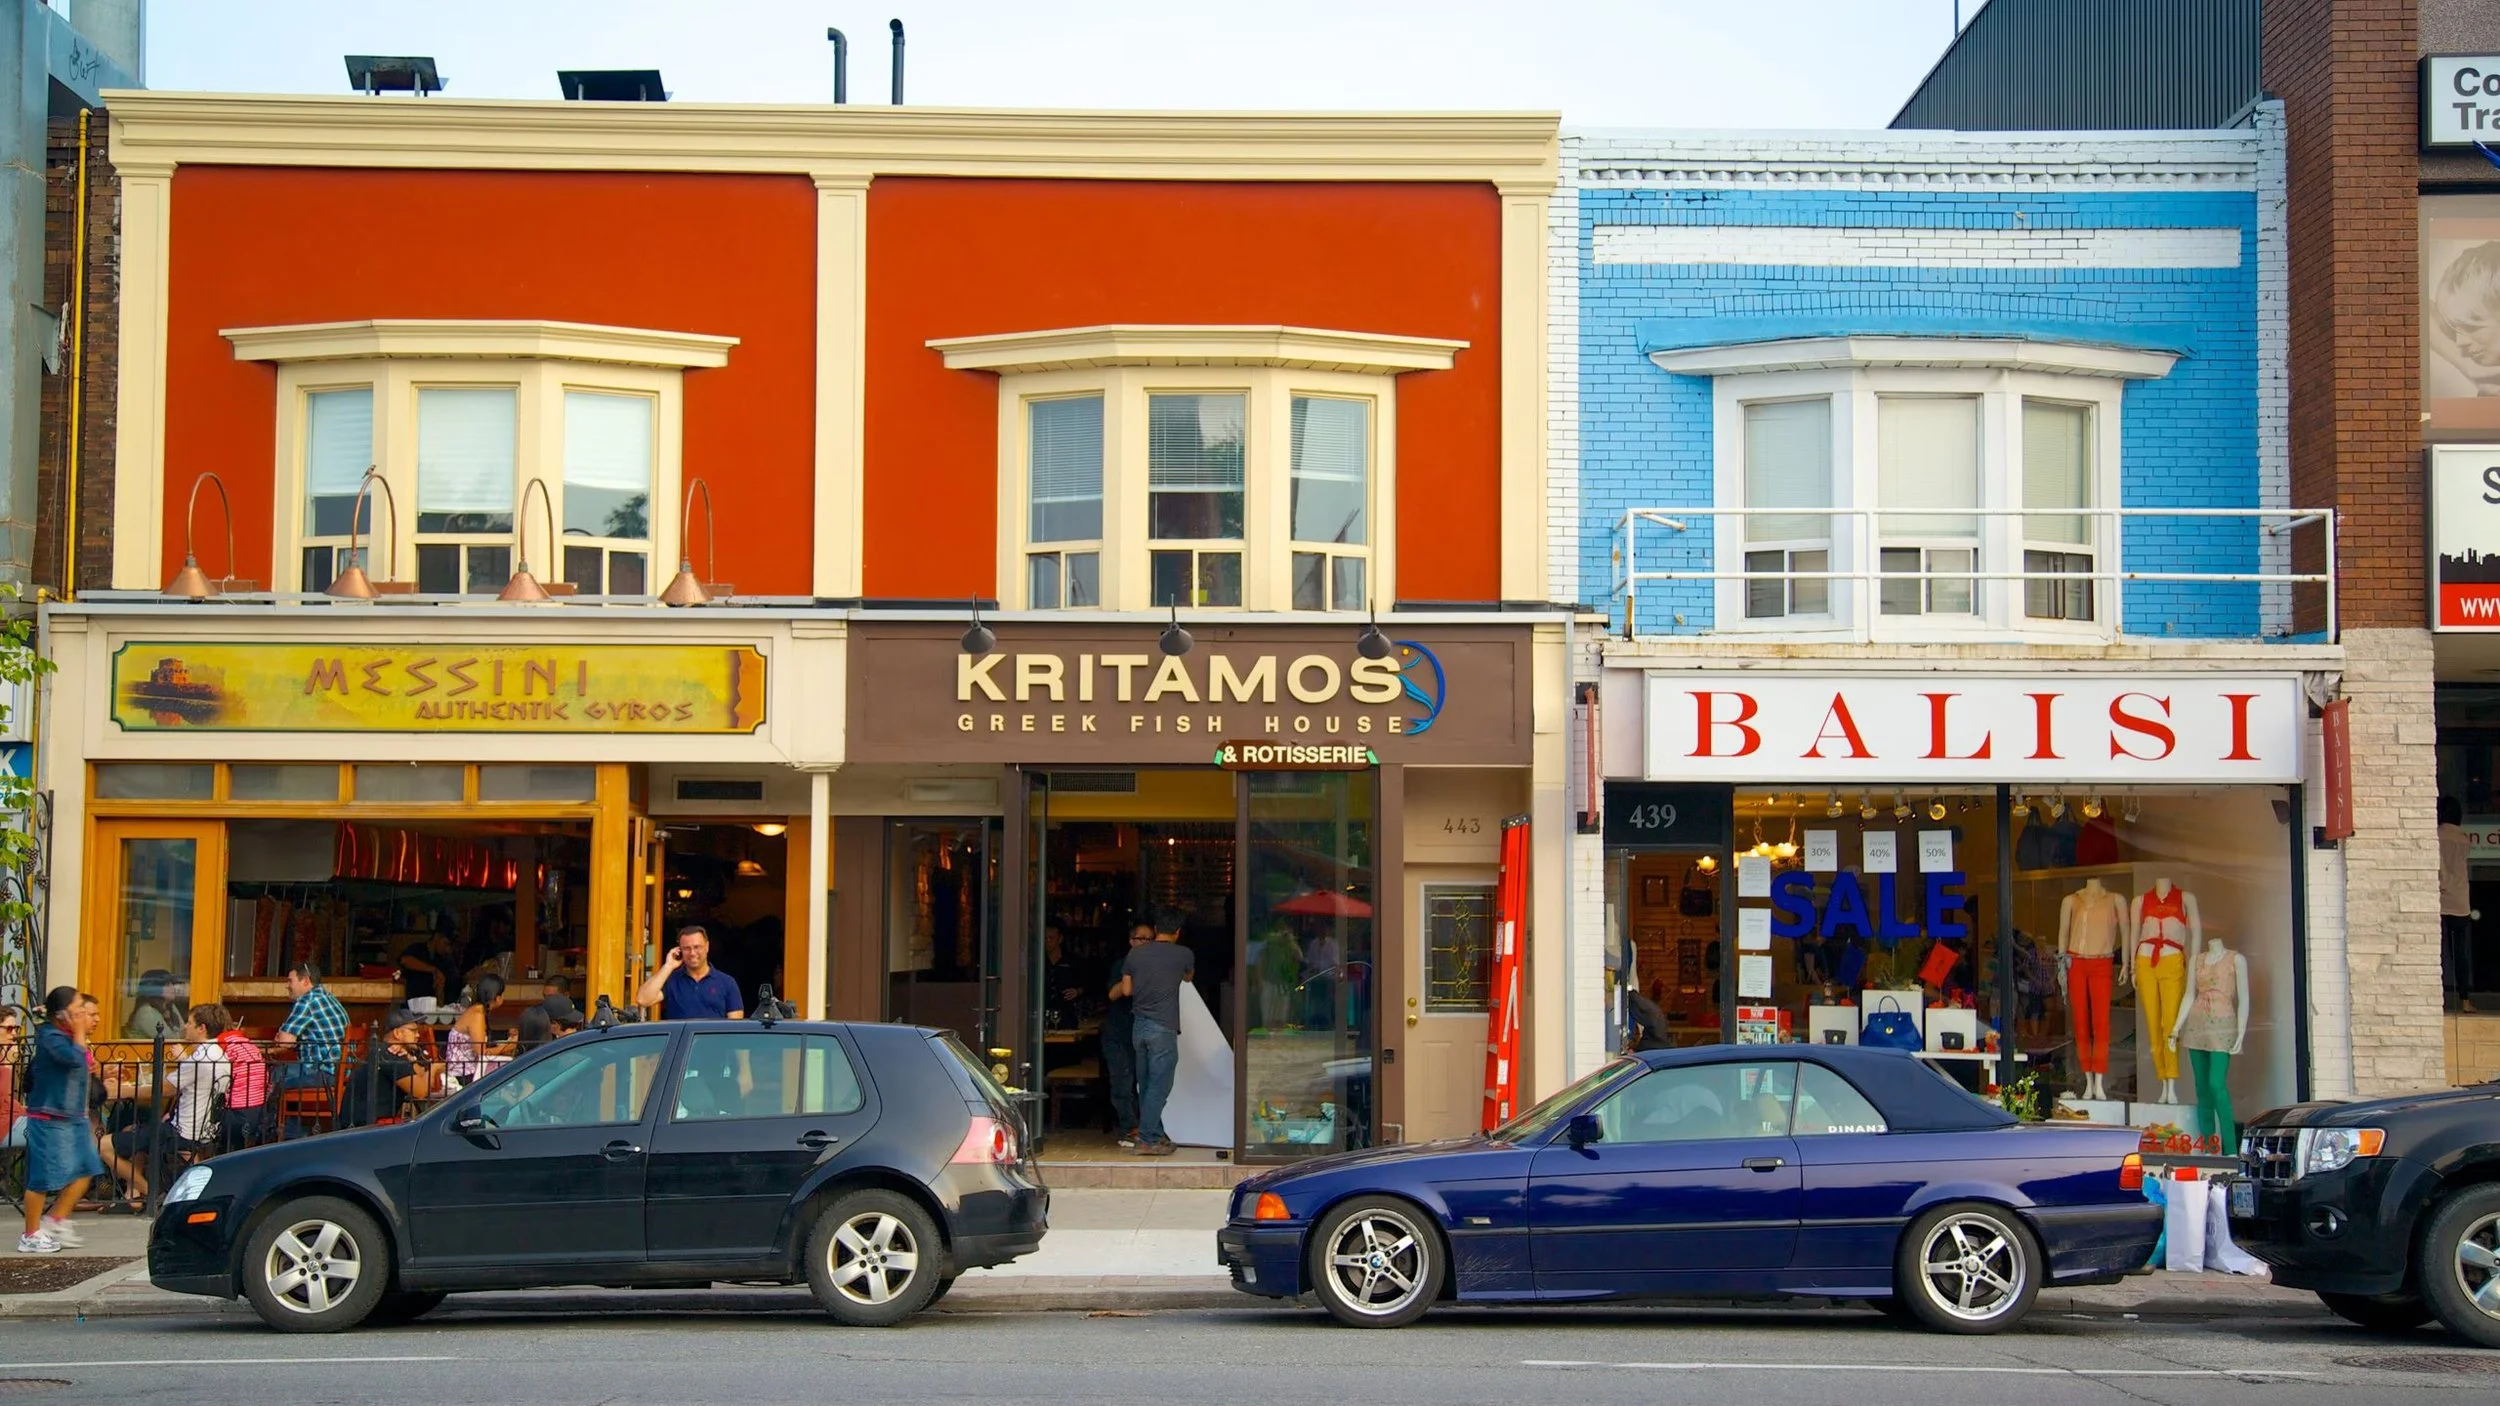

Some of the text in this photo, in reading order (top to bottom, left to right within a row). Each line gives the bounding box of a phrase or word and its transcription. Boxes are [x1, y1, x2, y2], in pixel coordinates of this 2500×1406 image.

[303, 657, 588, 697] MESSINI
[957, 653, 1402, 703] KRITAMOS
[415, 700, 694, 723] AUTHENTIC GYROS
[957, 713, 1402, 735] GREEK FISH HOUSE
[1683, 690, 2263, 762] BALISI
[1222, 745, 1367, 764] & ROTISSERIE
[2332, 710, 2343, 830] BALISI
[1443, 817, 1481, 834] 443
[1628, 803, 1677, 829] 439
[1811, 847, 1831, 857] 30%
[1869, 848, 1890, 858] 40%
[1925, 848, 1946, 858] 50%
[1771, 871, 1967, 938] SALE
